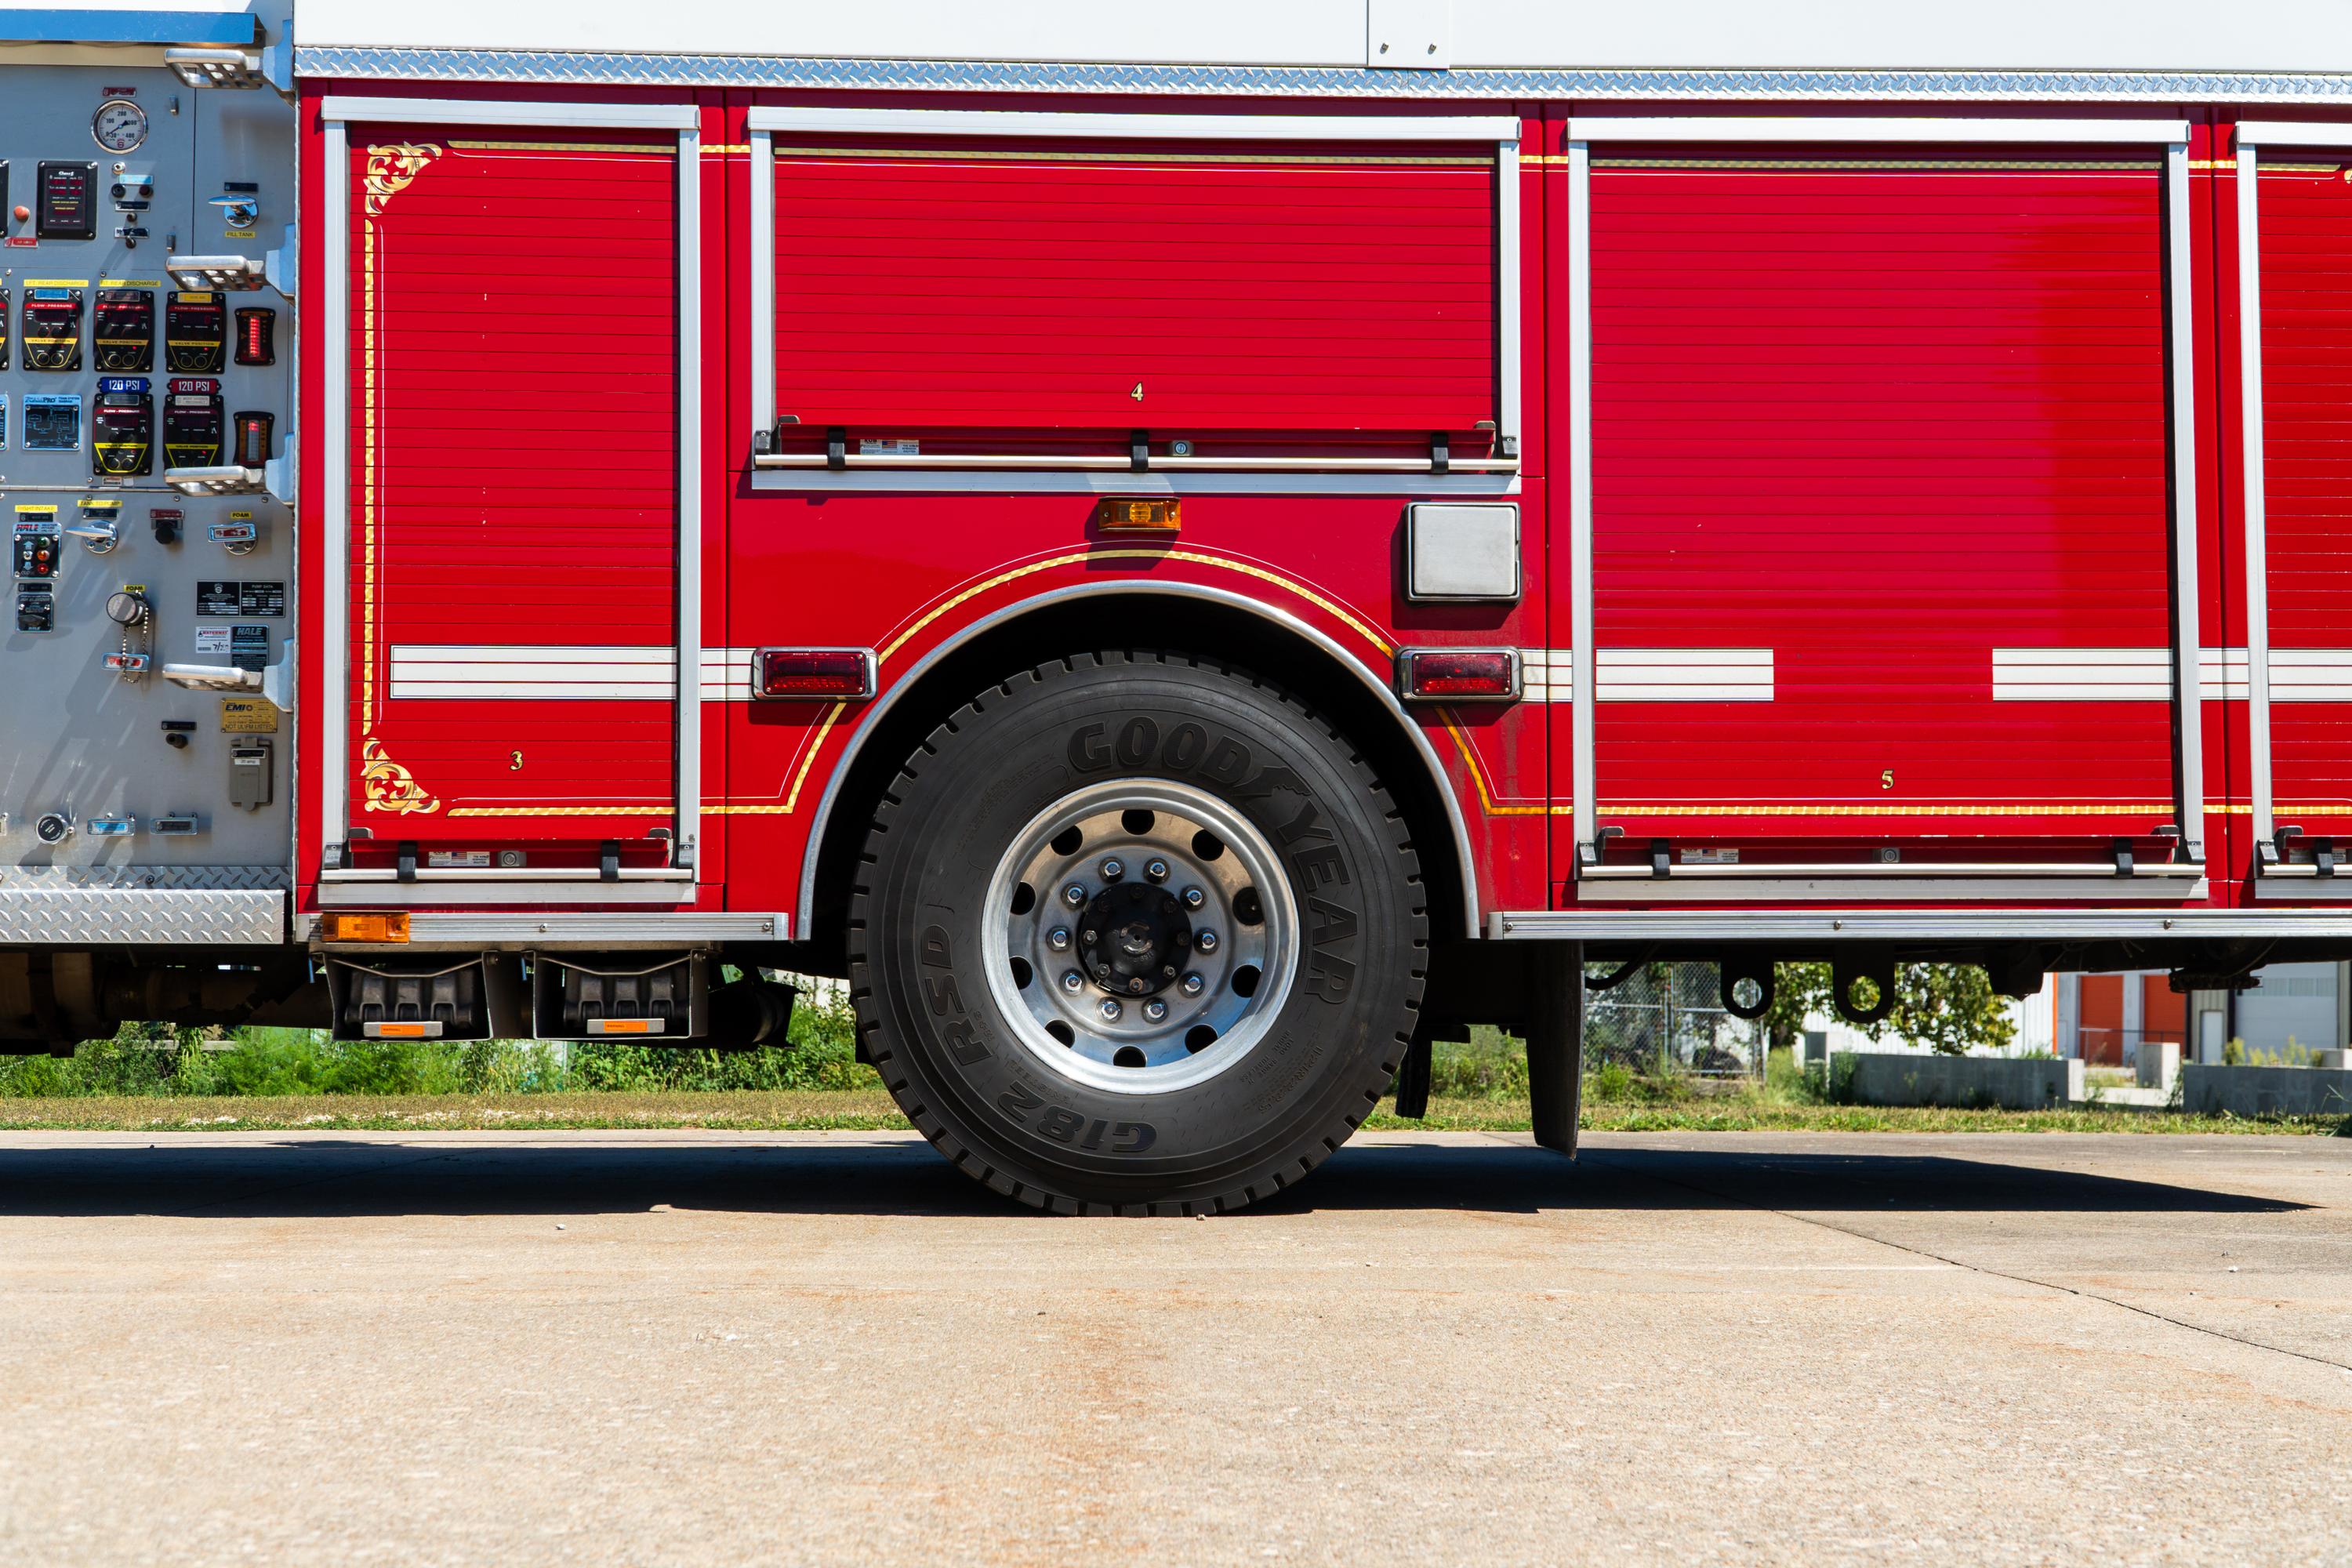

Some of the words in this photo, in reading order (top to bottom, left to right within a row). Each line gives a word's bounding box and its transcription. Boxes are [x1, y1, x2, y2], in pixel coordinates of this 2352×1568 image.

[109, 380, 123, 390] 120
[125, 380, 140, 390] PSI
[179, 381, 194, 391] 120
[195, 381, 210, 391] PSI
[1130, 381, 1144, 402] 4
[510, 750, 524, 771] 3
[1881, 769, 1895, 789] 5
[1068, 716, 1359, 1005] GOODYEAR
[920, 924, 994, 1067] RSD
[997, 1079, 1157, 1154] G182
